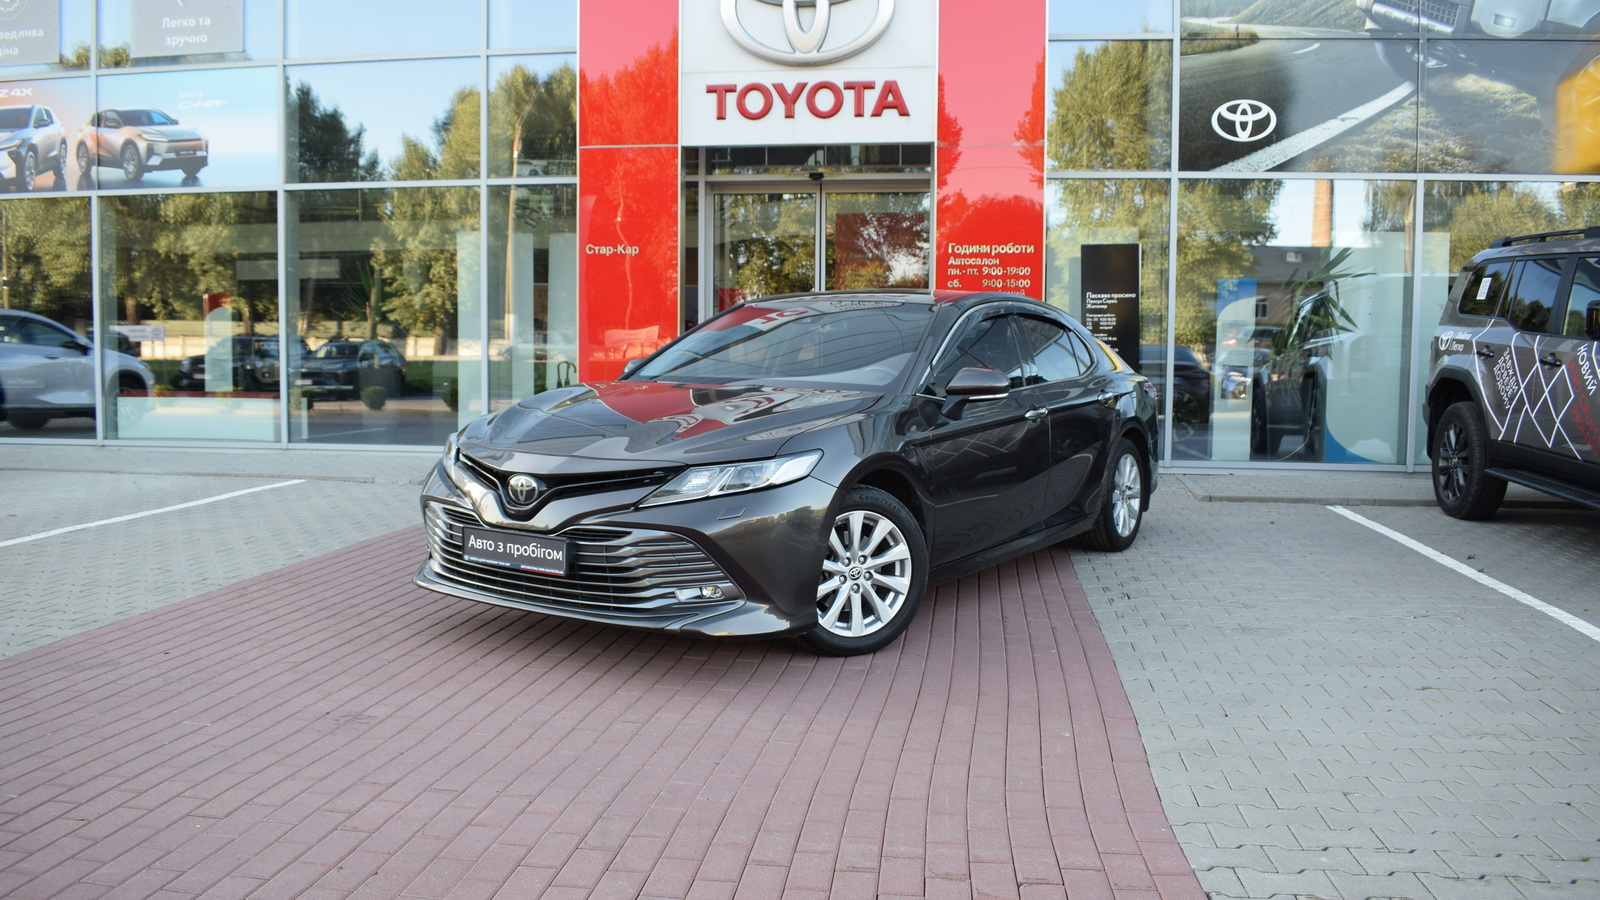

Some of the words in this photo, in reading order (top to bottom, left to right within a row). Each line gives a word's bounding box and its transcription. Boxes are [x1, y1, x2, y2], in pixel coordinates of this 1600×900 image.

[161, 17, 196, 29] Легко
[198, 17, 211, 26] та
[165, 34, 208, 47] зручно
[706, 80, 910, 120] TOYOTA
[586, 244, 640, 256] Стар-Кар
[948, 243, 990, 255] Години
[991, 242, 1034, 256] роботи
[948, 256, 999, 265] Автосалон
[947, 279, 962, 287] сб.
[1566, 353, 1582, 393] LAND
[1577, 343, 1598, 396] НОВИЙ
[468, 534, 495, 551] Авто
[497, 542, 504, 552] з
[506, 542, 563, 561] пробігом
